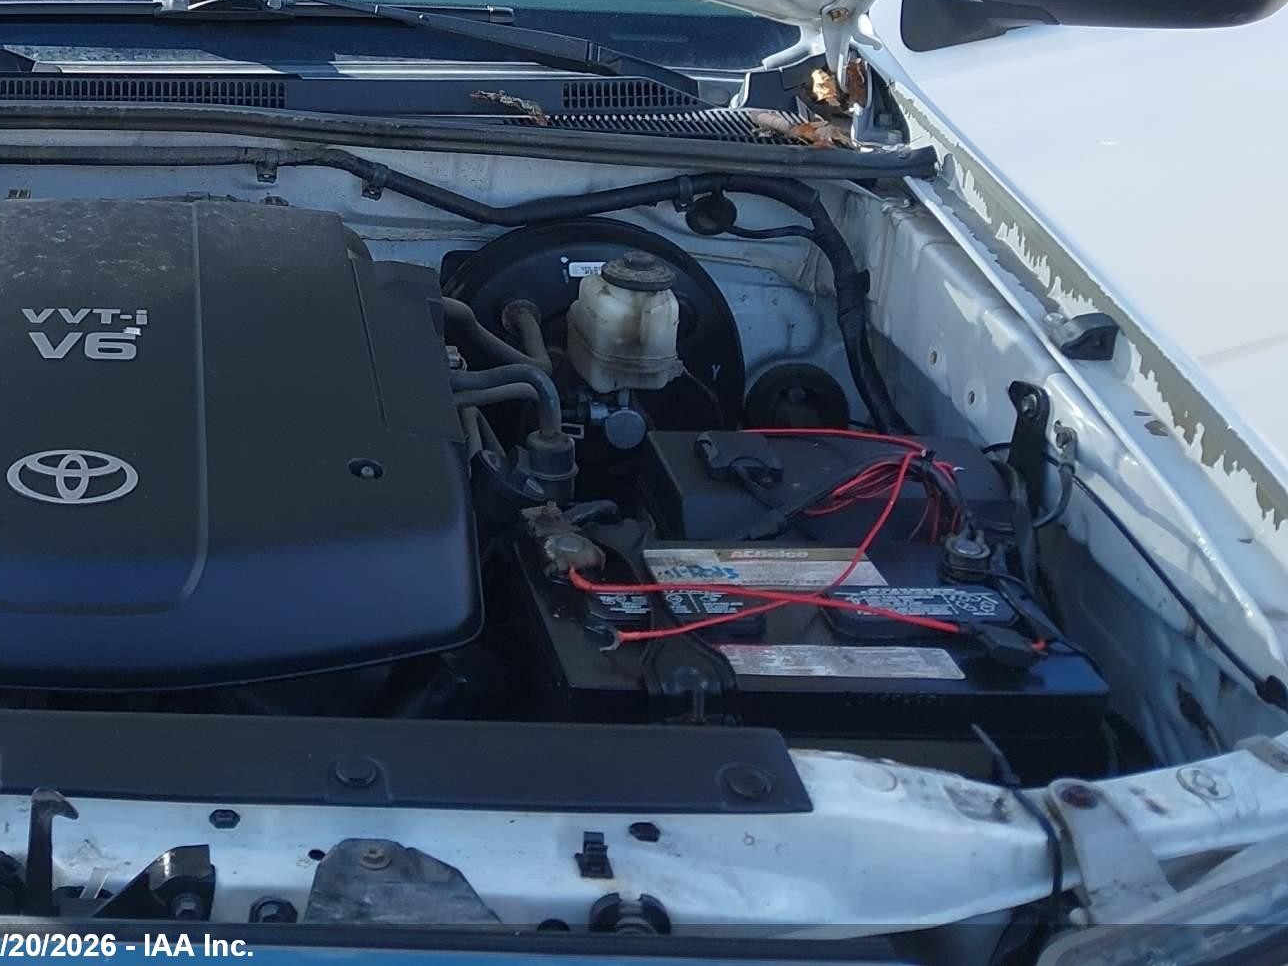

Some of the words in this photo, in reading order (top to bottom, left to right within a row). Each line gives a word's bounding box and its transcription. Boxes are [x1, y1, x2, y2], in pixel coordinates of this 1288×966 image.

[21, 308, 148, 325] VVT-i
[28, 331, 137, 360] V6
[730, 550, 809, 559] ACDelco
